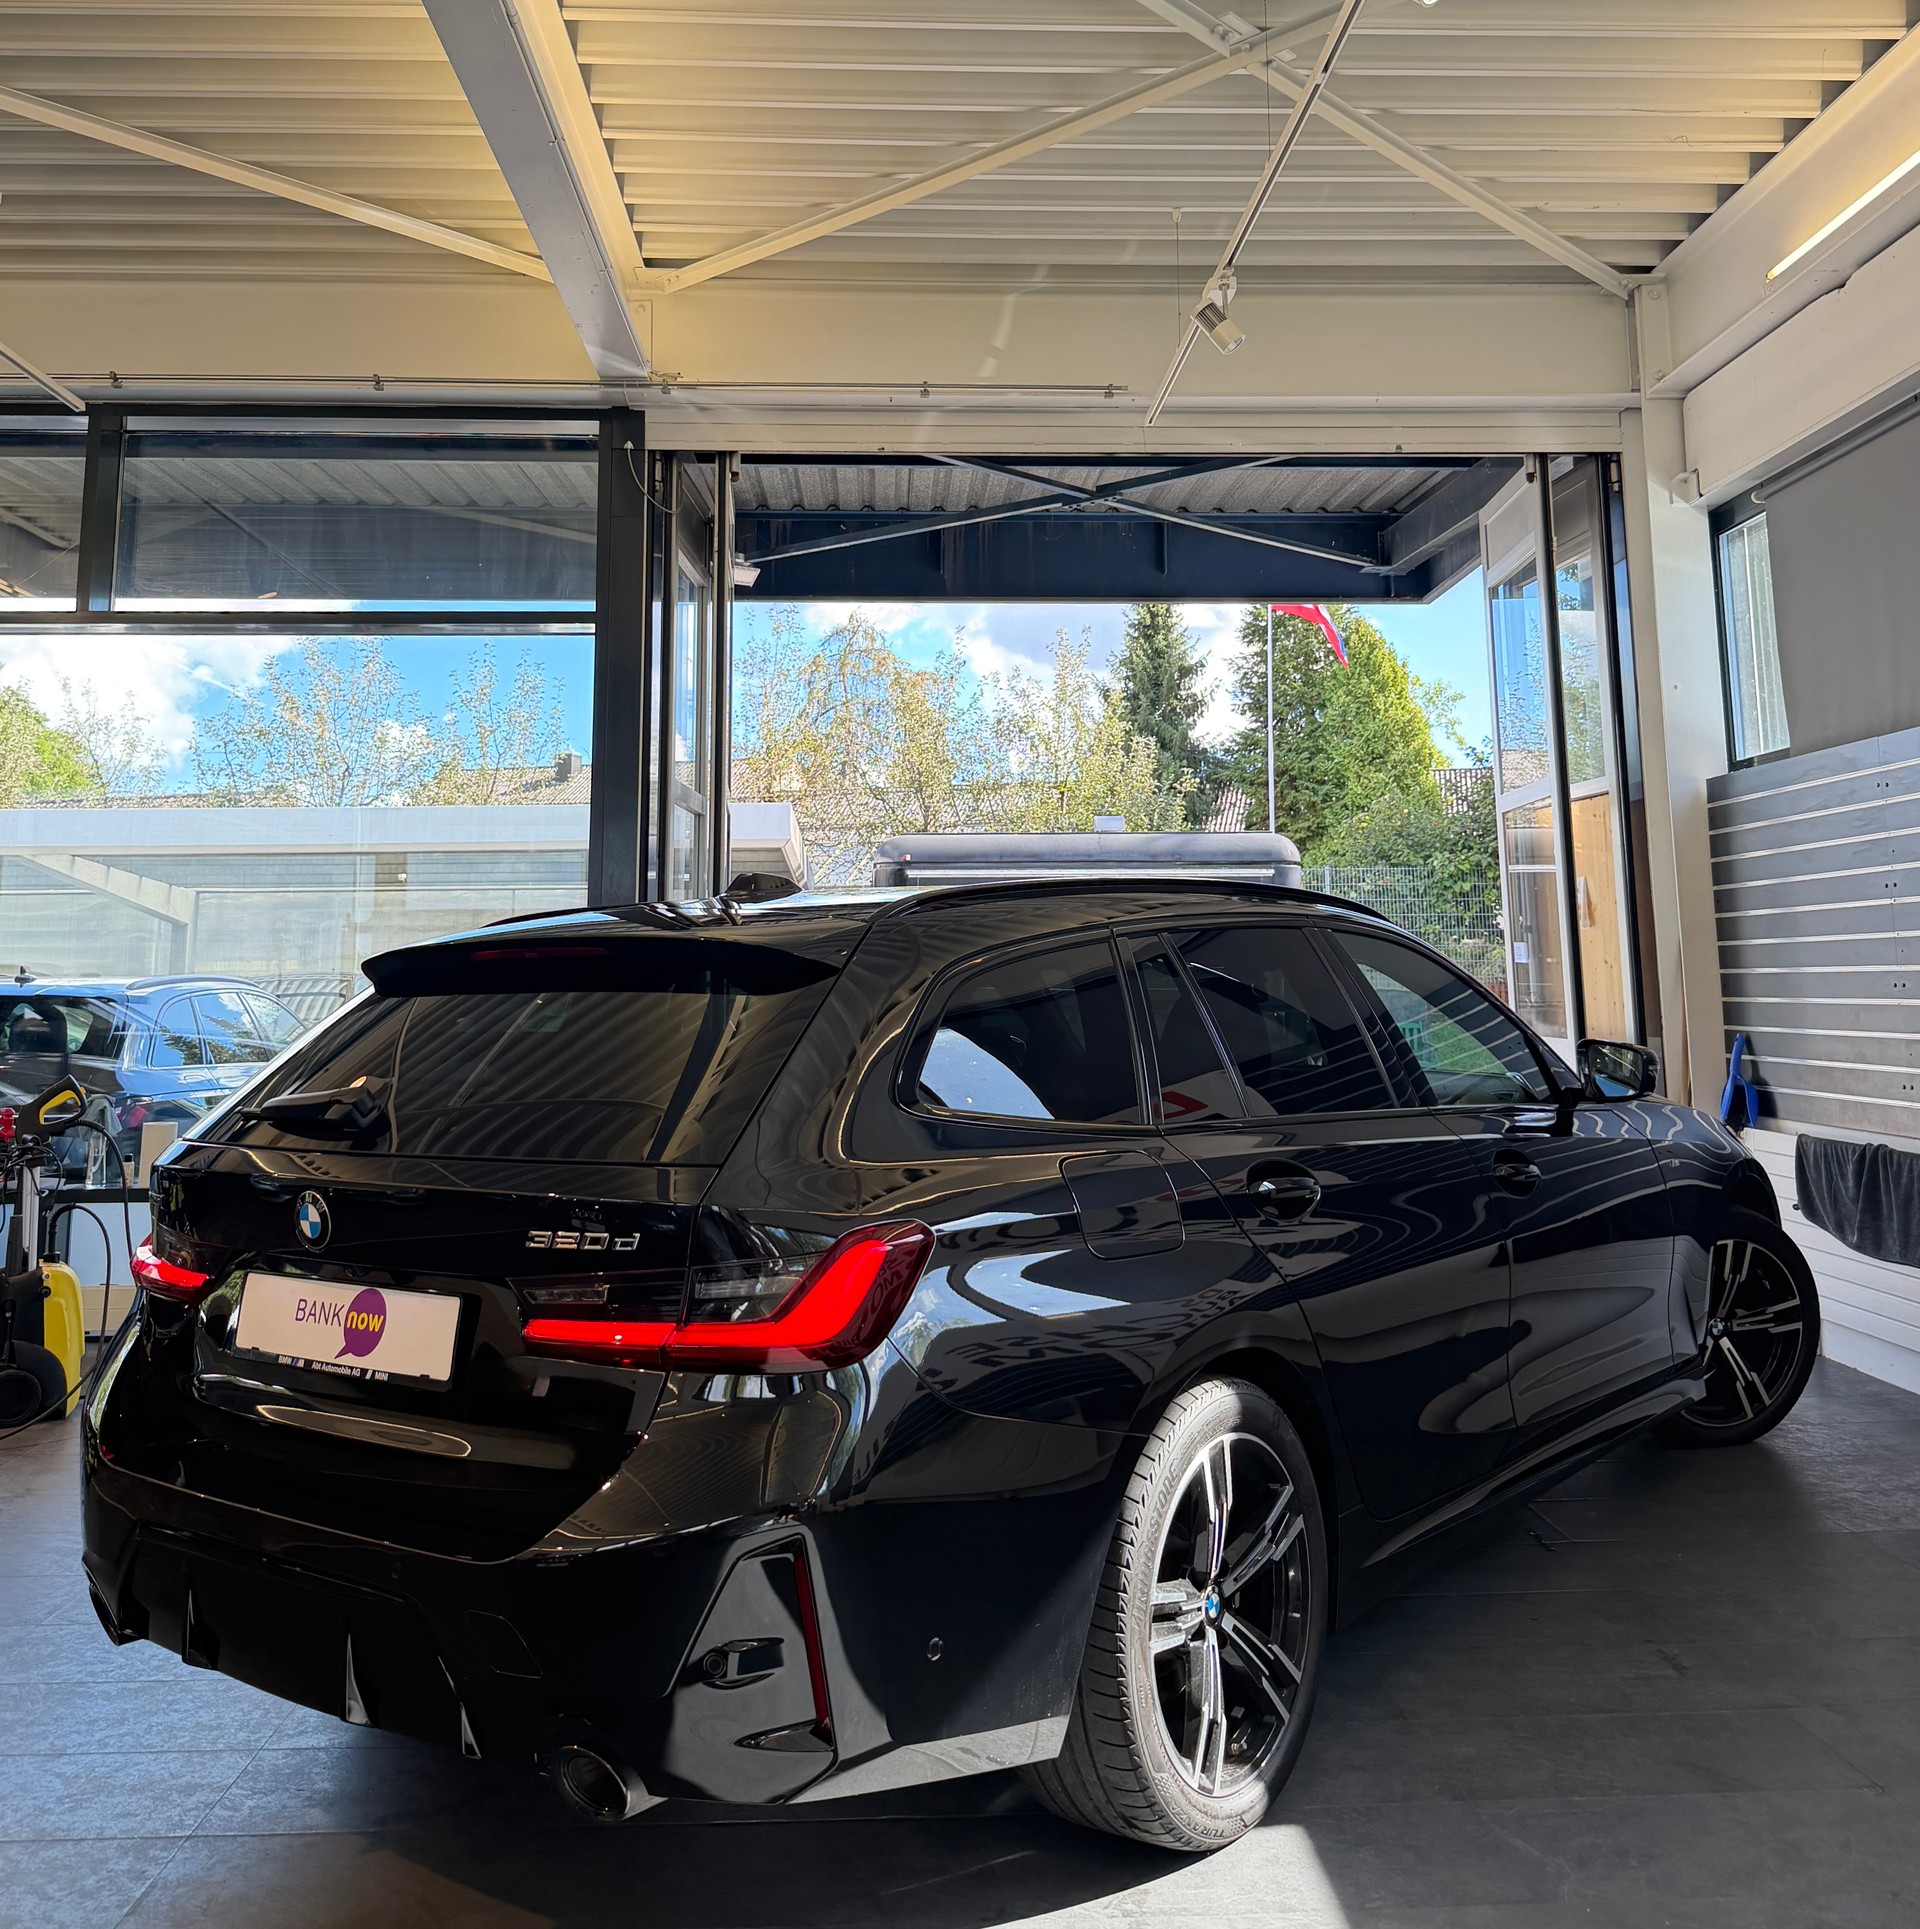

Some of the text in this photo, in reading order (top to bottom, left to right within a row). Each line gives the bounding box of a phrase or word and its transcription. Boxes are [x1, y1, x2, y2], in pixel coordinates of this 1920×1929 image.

[295, 1298, 384, 1333] BANK now
[278, 1355, 293, 1366] BMW
[311, 1360, 322, 1371] Abt
[321, 1363, 352, 1377] Automobile
[351, 1367, 361, 1378] AG
[374, 1371, 389, 1382] MINI
[1170, 1803, 1225, 1839] TURANZA
